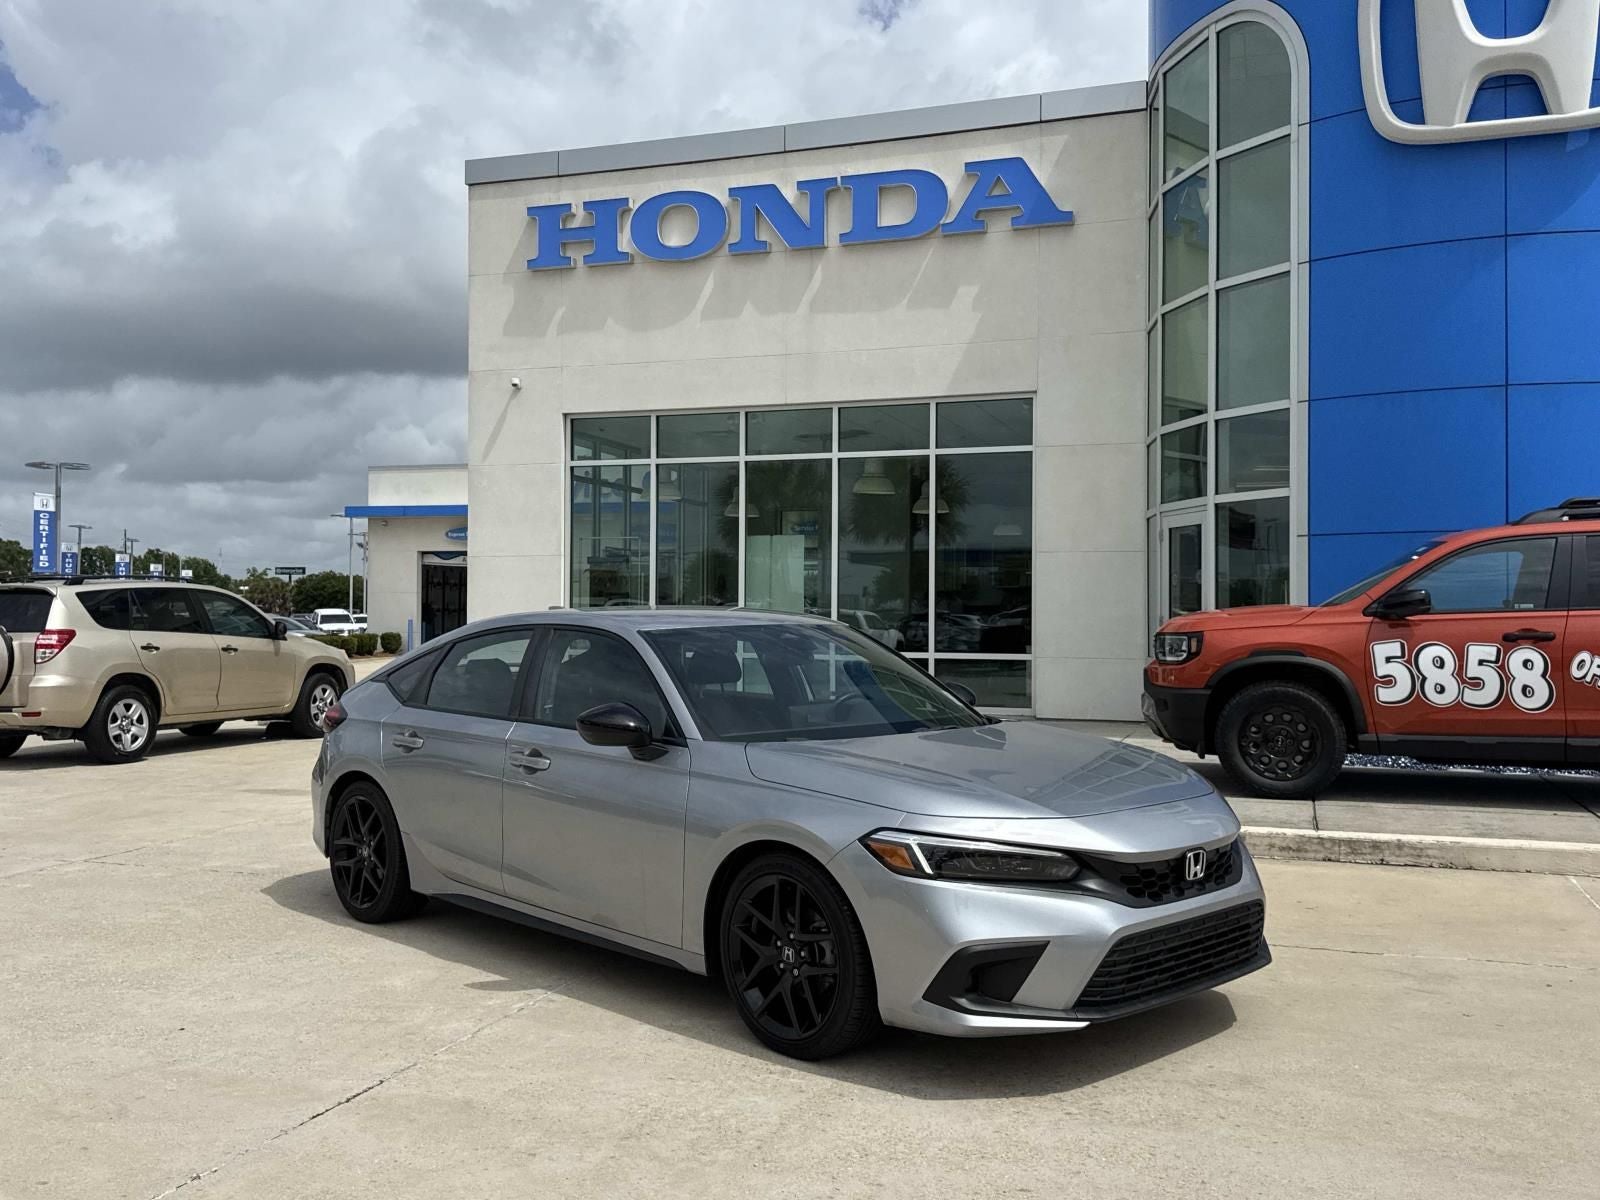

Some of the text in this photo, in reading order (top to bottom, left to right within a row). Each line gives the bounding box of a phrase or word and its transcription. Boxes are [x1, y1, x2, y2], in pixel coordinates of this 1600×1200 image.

[526, 156, 1074, 270] HONDA
[39, 512, 49, 567] CERTIFIED
[1370, 639, 1556, 713] 5858
